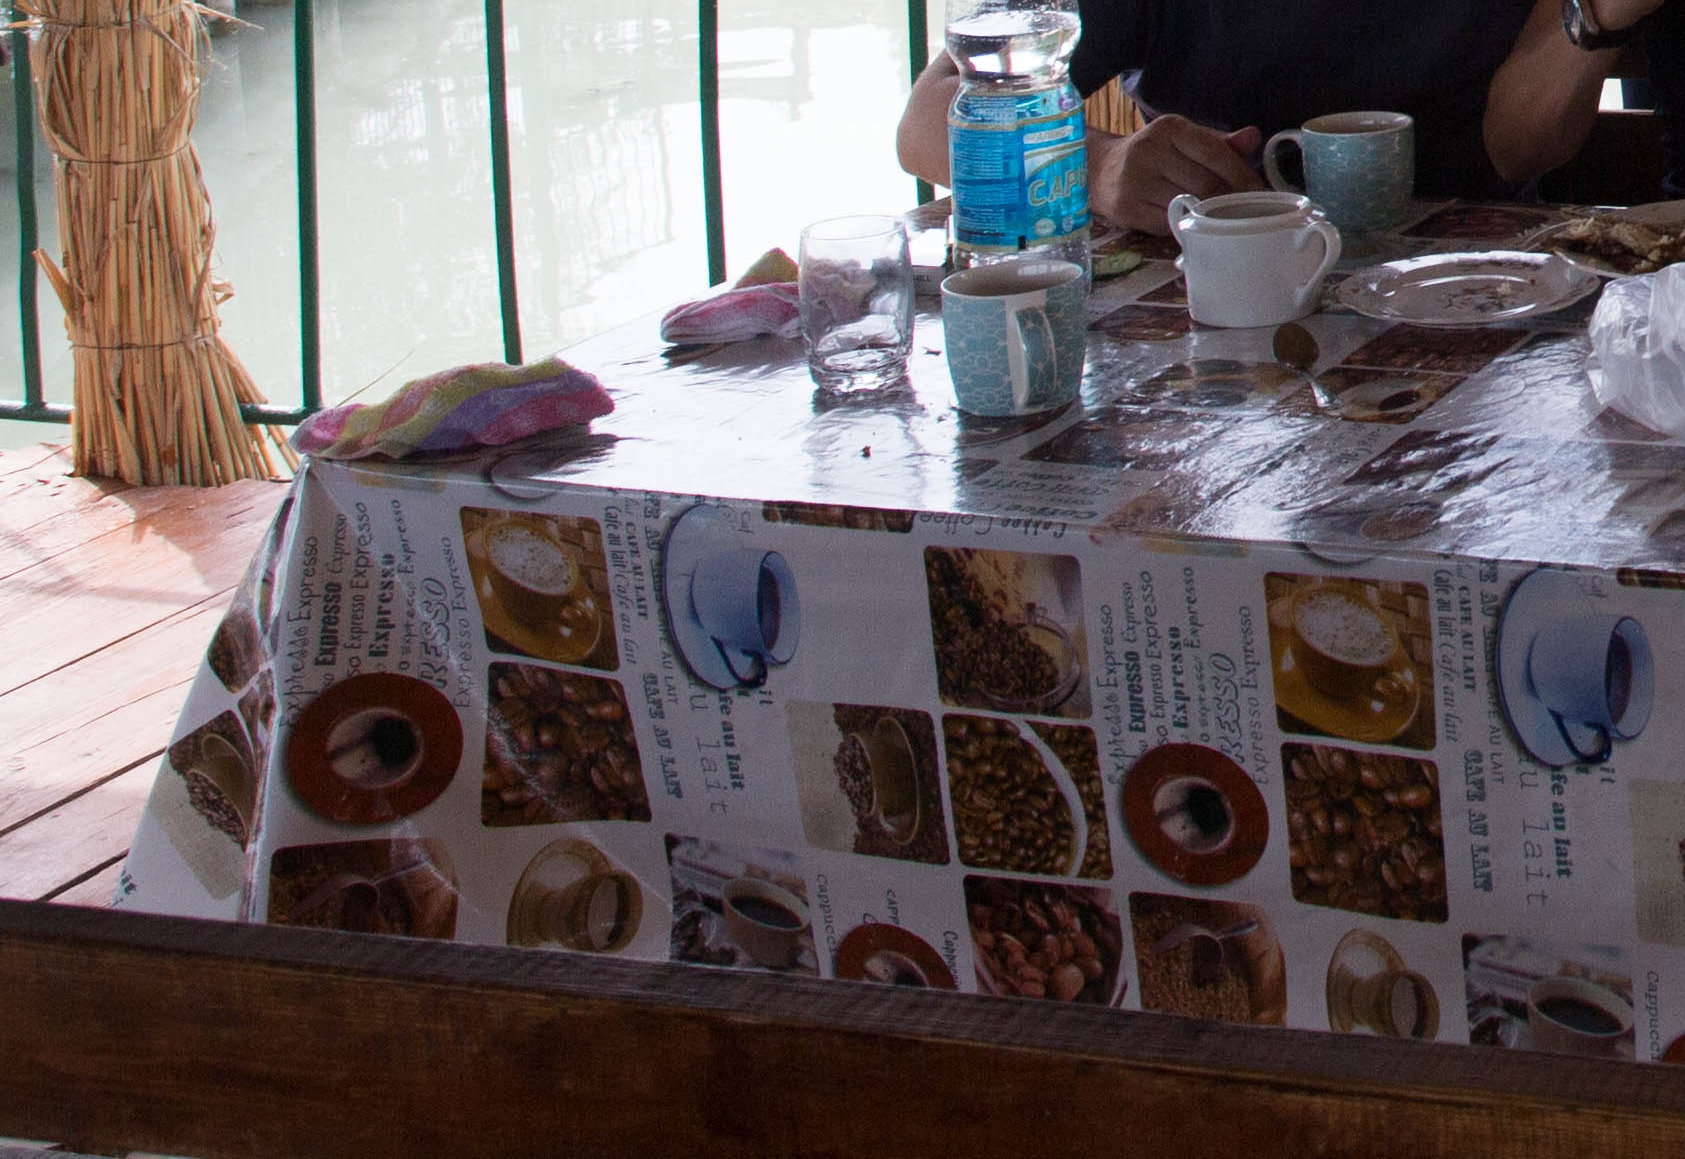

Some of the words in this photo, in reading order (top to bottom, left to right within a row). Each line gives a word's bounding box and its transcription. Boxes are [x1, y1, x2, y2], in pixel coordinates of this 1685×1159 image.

[390, 499, 415, 575] Expresso
[604, 506, 623, 531] Cafe
[350, 502, 373, 589] Expresso
[607, 533, 622, 547] au
[610, 550, 628, 569] lait
[626, 522, 640, 558] CAFE
[287, 536, 320, 622] Expresso
[314, 582, 341, 667] Expresso
[329, 513, 350, 574] Expresso
[441, 536, 467, 611] Expresso
[631, 562, 644, 585] AU
[1433, 570, 1457, 595] Cafe
[343, 594, 367, 650] Expresso
[368, 554, 395, 658] Expresso
[633, 585, 648, 620] LAIT
[1120, 582, 1141, 644] Expresso
[1139, 570, 1162, 660] Expresso
[1182, 567, 1204, 649] Expresso
[1437, 597, 1454, 613] au
[1459, 585, 1474, 624] CAFE
[1097, 604, 1122, 688] Expresso
[1438, 616, 1457, 637] lait
[1461, 628, 1474, 650] AU
[452, 618, 473, 710] Expresso
[660, 650, 673, 670] AU
[1239, 606, 1261, 691] Expresso
[1438, 642, 1459, 680] Cafe
[663, 675, 678, 704] LAIT
[1124, 650, 1146, 734] Expresso
[1149, 664, 1168, 719] Expresso
[1167, 626, 1190, 729] Expresso
[1462, 651, 1476, 692] LAIT
[721, 722, 735, 748] au
[1488, 724, 1502, 745] AU
[695, 735, 729, 815] lait
[726, 753, 744, 791] lait
[1490, 752, 1505, 784] LAIT
[1553, 801, 1566, 830] au
[1523, 818, 1550, 906] lait
[1554, 837, 1573, 879] lait
